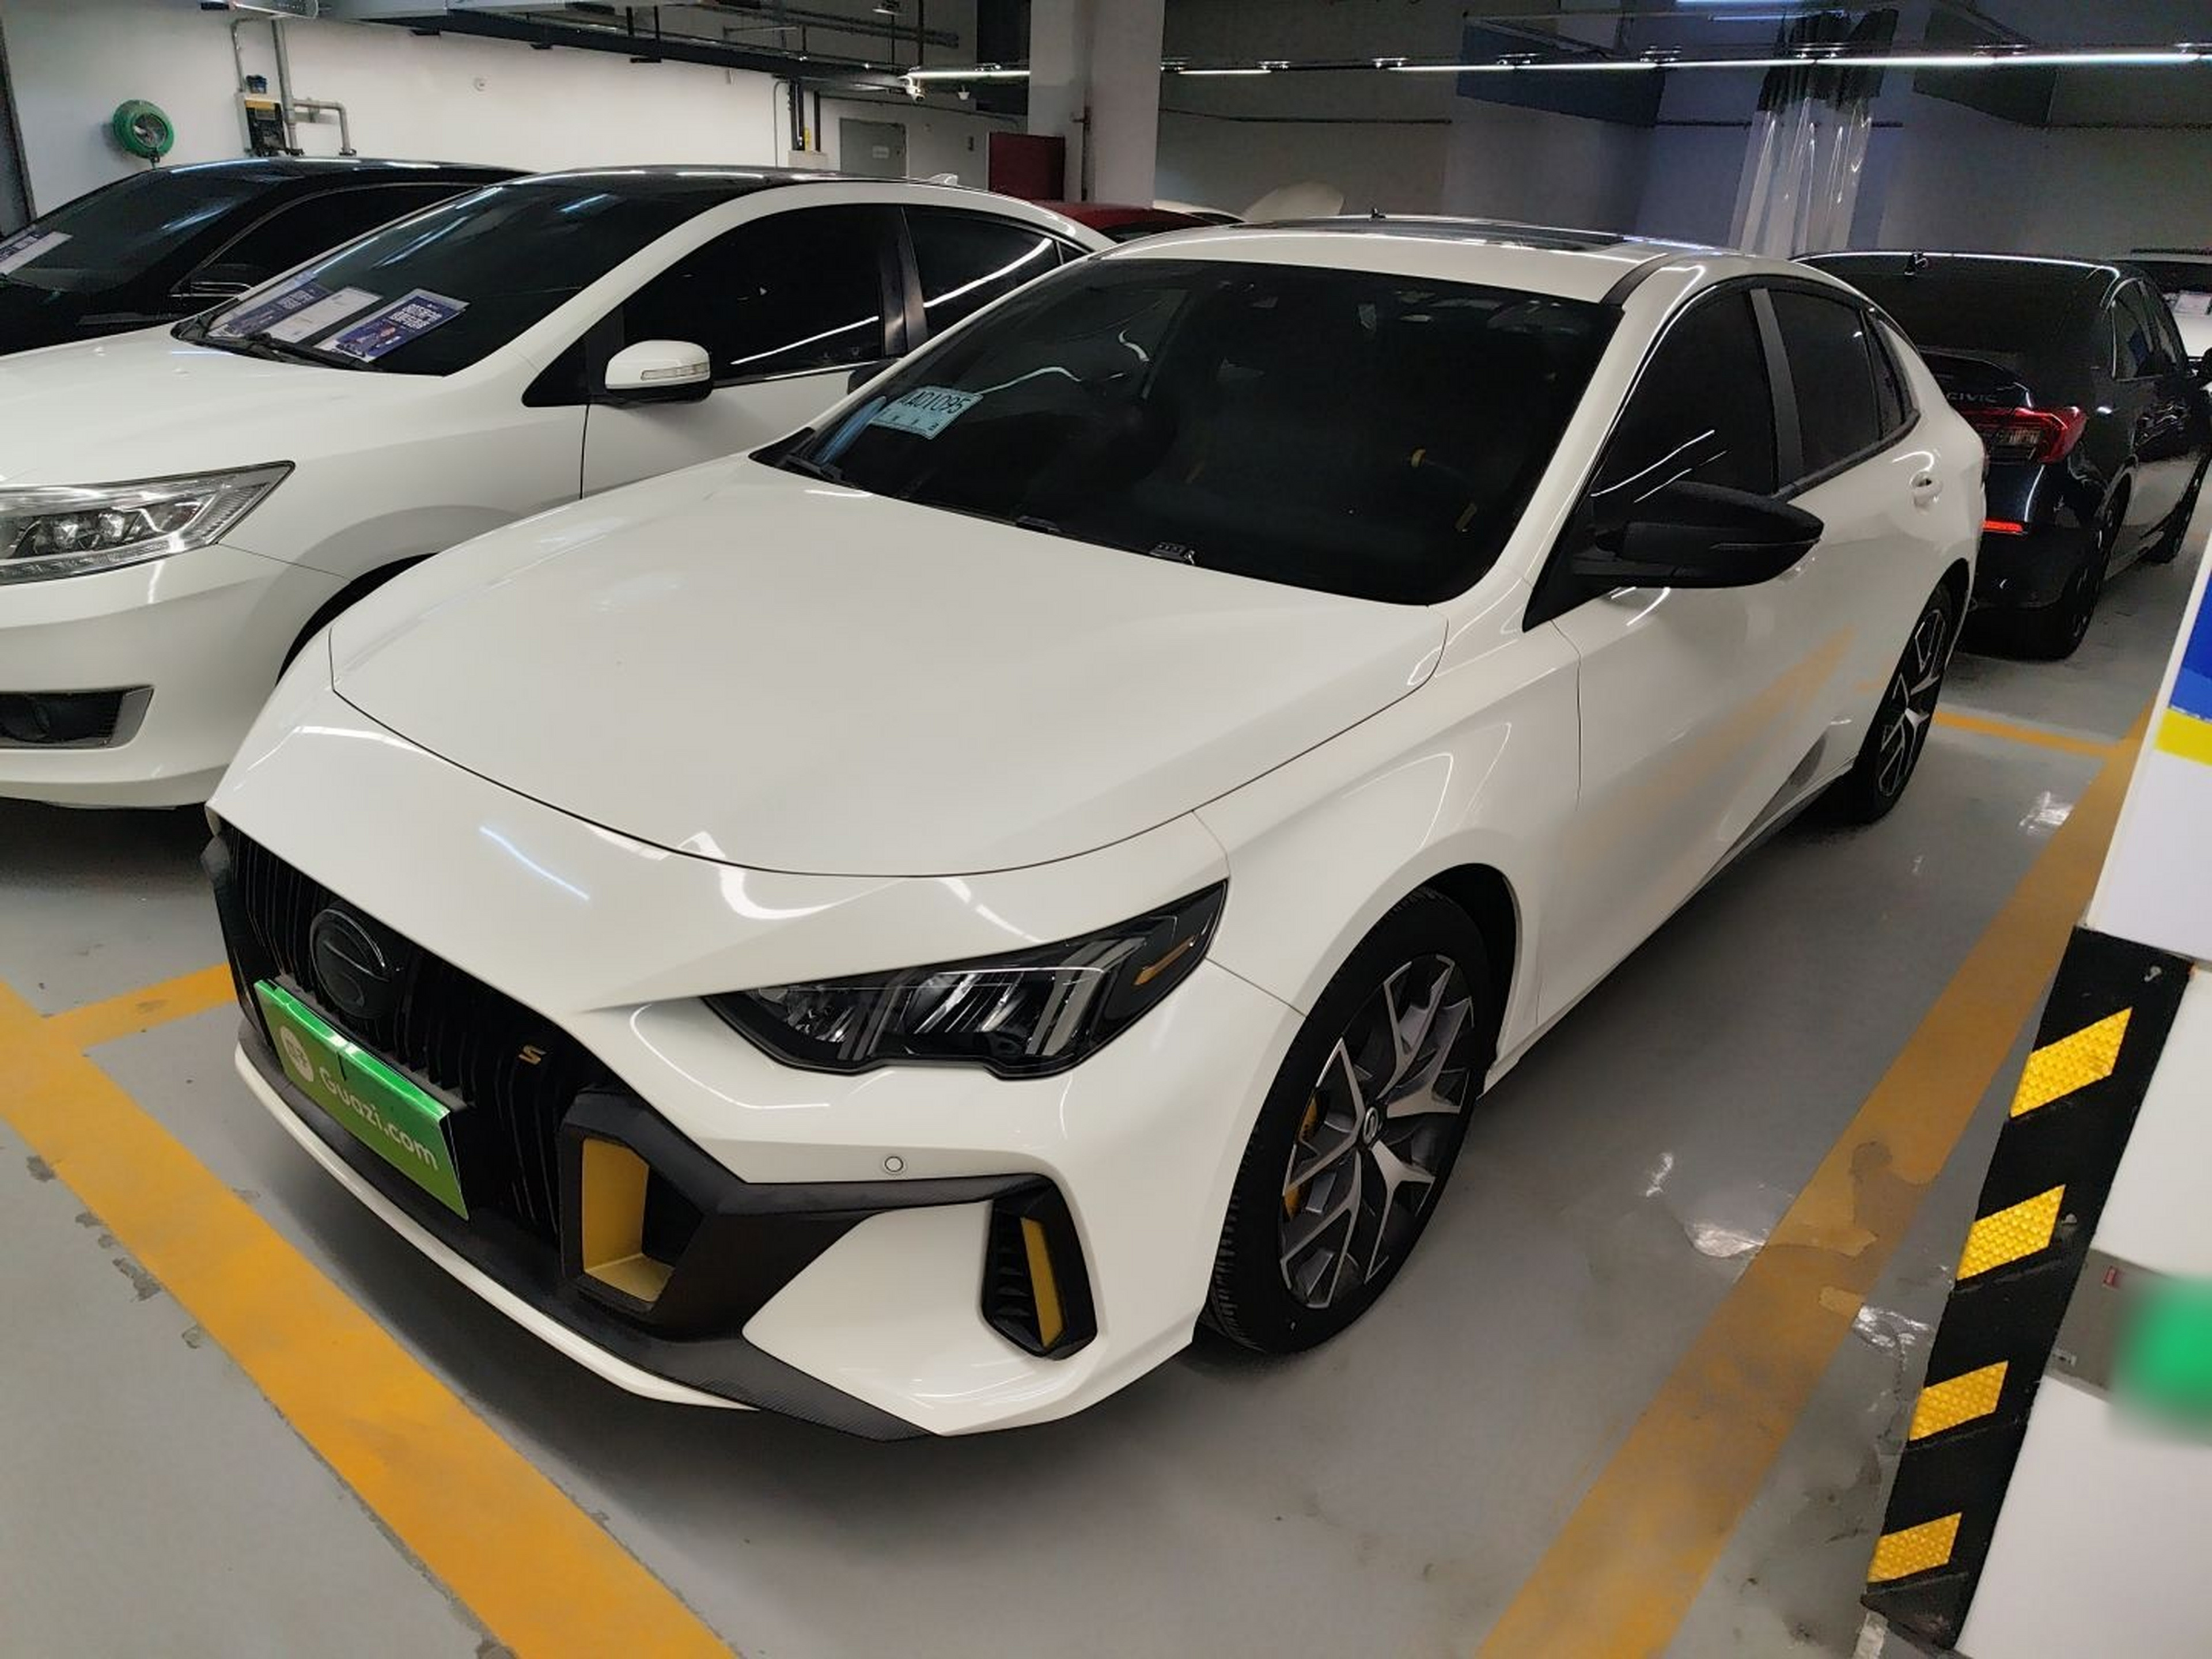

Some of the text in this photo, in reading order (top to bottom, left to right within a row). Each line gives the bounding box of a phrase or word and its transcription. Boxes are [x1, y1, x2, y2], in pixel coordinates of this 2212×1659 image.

[1946, 393, 1997, 403] CIVIC
[519, 1045, 547, 1065] S
[320, 1066, 438, 1171] Guazi.com
